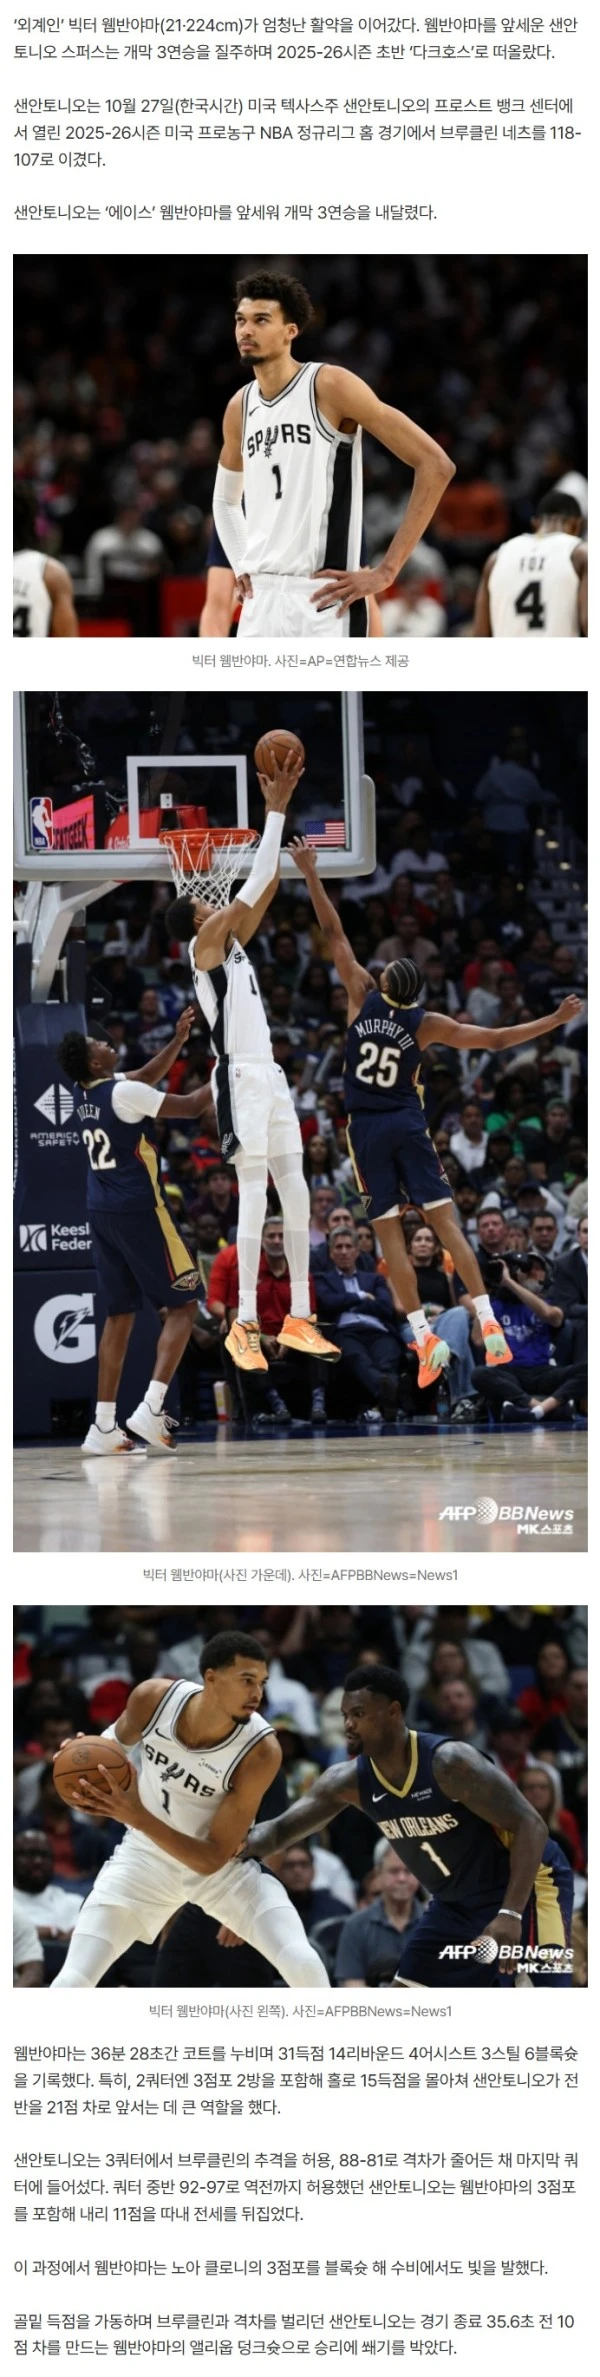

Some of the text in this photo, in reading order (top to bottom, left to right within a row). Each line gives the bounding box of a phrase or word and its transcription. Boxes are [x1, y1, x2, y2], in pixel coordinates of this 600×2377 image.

[68, 16, 97, 34] 빅터
[262, 16, 307, 34] 엄청난
[309, 16, 354, 34] 활약을
[358, 16, 420, 34] 이어갔다.
[423, 16, 498, 34] 웸반야마를
[500, 17, 545, 34] 앞세운
[548, 16, 579, 33] 샌안
[13, 43, 58, 61] 토니오
[61, 43, 120, 61] 스퍼스는
[123, 43, 153, 61] 개막
[156, 43, 211, 61] 3연승을
[214, 43, 272, 61] 질주하며
[276, 43, 373, 61] 2025-26시즌
[375, 43, 406, 60] 초반
[492, 43, 555, 61] 떠올랐다.
[13, 97, 573, 117] 샌안토니오는 10월 27일(한국시간) 미국 텍사스주 샌안토니오의 프로스트 뱅크 센터에
[13, 124, 582, 142] 서 열린 2025-26시즌 미국 프로농구 NBA 정규리그 홈 경기에서 브루클린 네츠를 118-
[13, 151, 106, 168] 107로 이겼다.
[247, 423, 311, 459] SPURS
[272, 464, 283, 500] 1
[515, 580, 546, 630] 4
[355, 1018, 415, 1050] MURPHY III
[355, 1041, 401, 1088] 25
[82, 1128, 117, 1170] 22
[51, 1222, 90, 1237] Keesl
[51, 1238, 92, 1251] Feder
[34, 1293, 97, 1364] G
[161, 1788, 171, 1816] 1
[400, 1813, 459, 1838] ORLEANS
[421, 1841, 451, 1877] 1
[13, 2045, 579, 2062] 웸반야마는 36분 28초간 코트를 누비며 31득점 14리바운드 4어시스트 3스틸 6블록슛
[13, 2071, 579, 2091] 을 기록했다. 특히, 2쿼터엔 3점포 2방을 포함해 홀로 15득점을 몰아쳐 샌안토니오가 전
[13, 2151, 578, 2171] 샌안토니오는 3쿼터에서 브루클린의 추격을 허용, 88-81로 격차가 줄어든 채 마지막 쿼
[13, 2178, 577, 2196] 터에 들어섰다. 쿼터 중반 92-97로 역전까지 허용했던 샌안토니오는 웸반야마의 3점포
[13, 2259, 548, 2277] 이 과정에서 웸반야마는 노아 클로니의 3점포를 블록슛 해 수비에서도 빛을 발했다.
[13, 2313, 575, 2330] 골밑 득점을 가동하며 브루클린과 격차를 벌리던 샌안토니오는 경기 종료 35.6초 전 10
